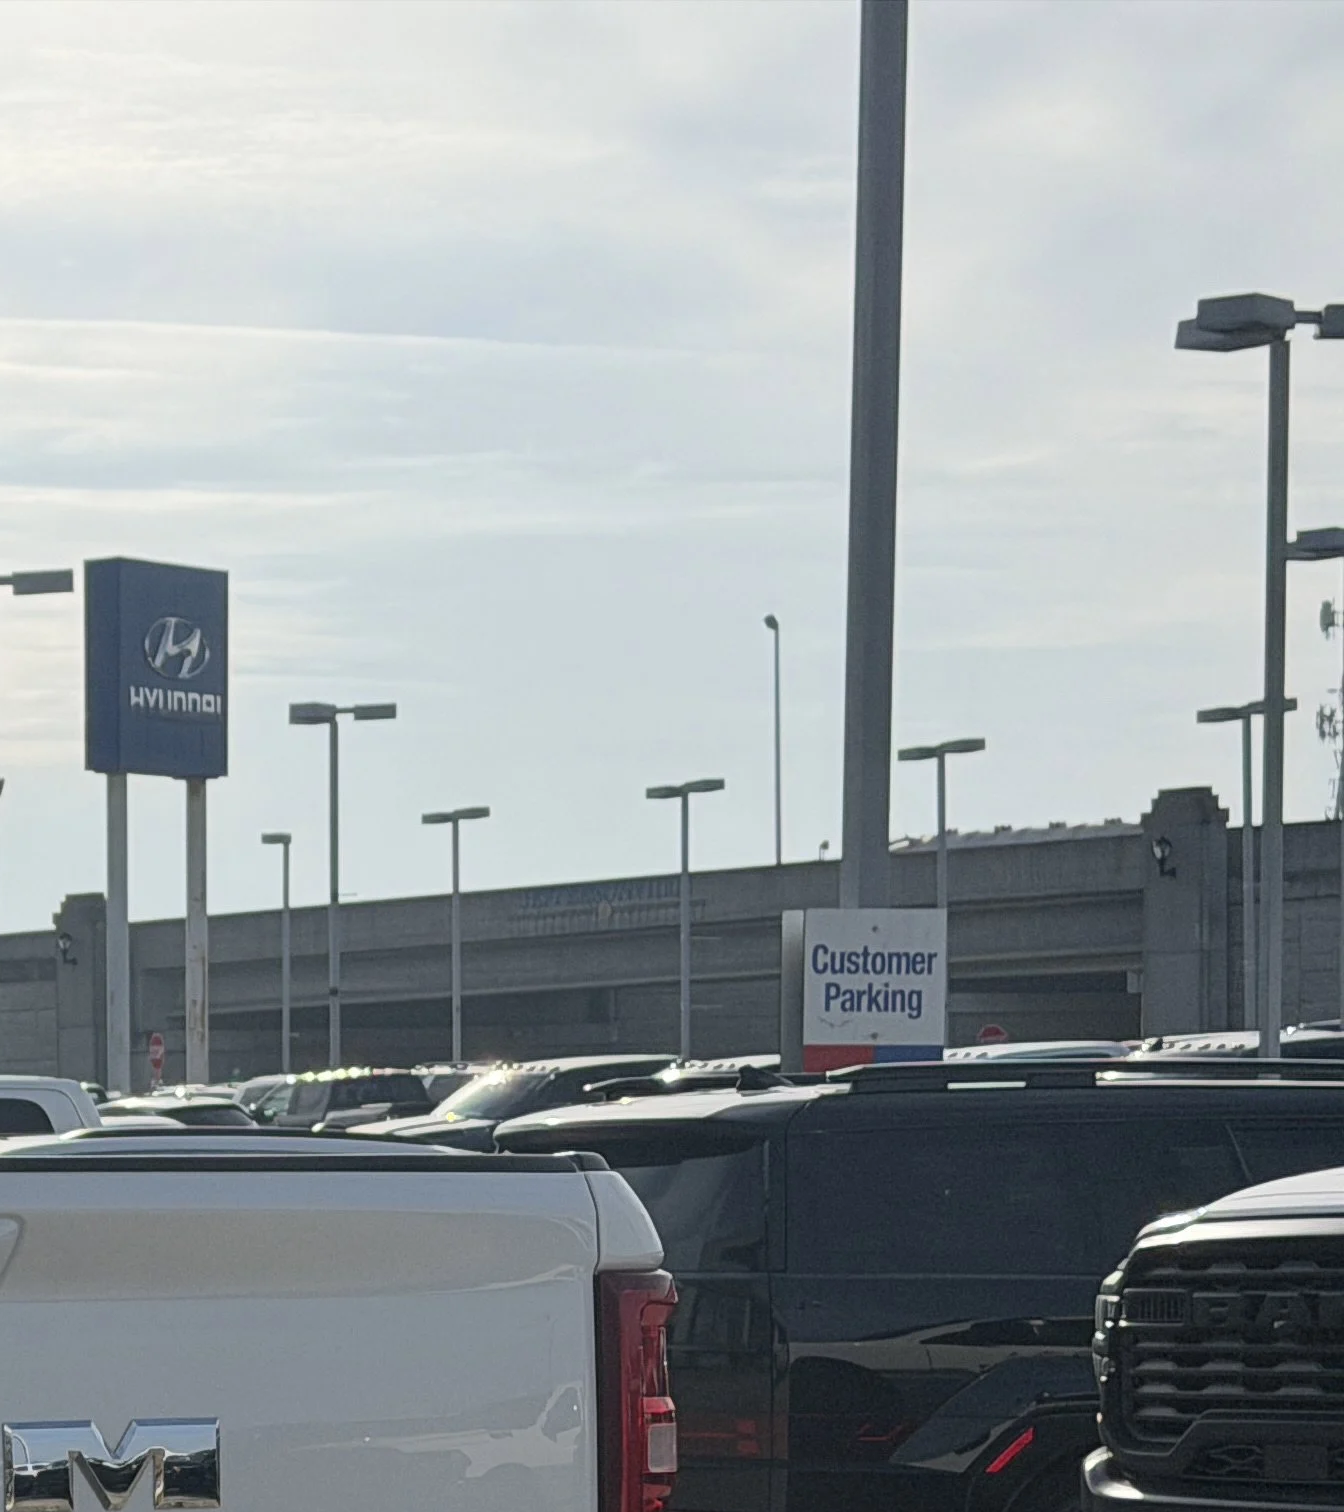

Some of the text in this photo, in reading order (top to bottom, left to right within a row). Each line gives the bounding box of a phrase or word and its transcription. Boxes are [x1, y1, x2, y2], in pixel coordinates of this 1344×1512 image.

[130, 686, 221, 715] HYUNDAI
[812, 944, 937, 975] Customer
[824, 982, 922, 1019] Parking
